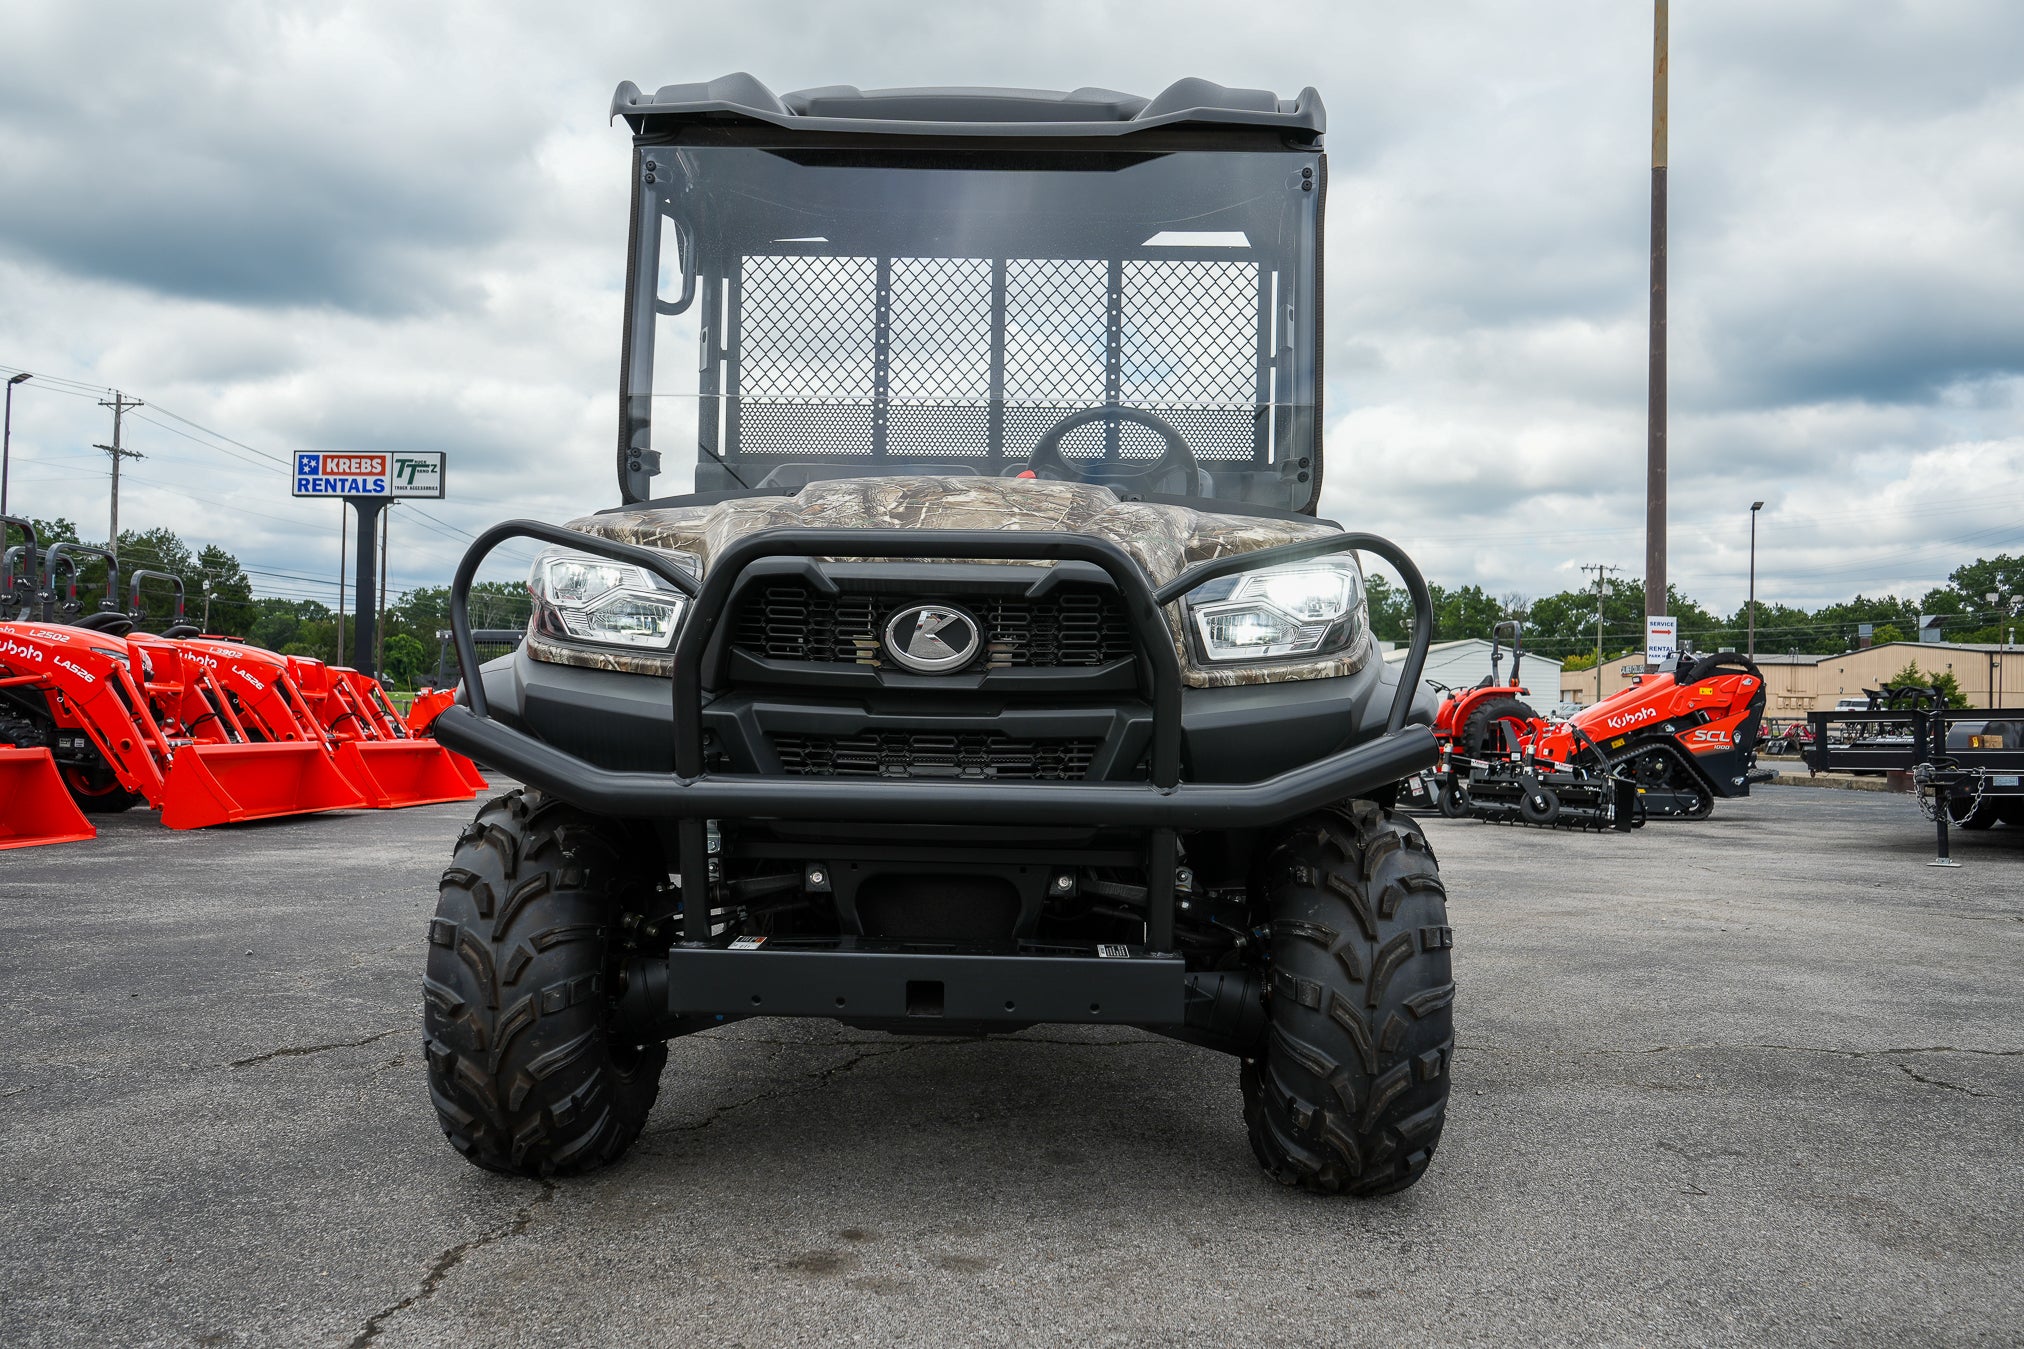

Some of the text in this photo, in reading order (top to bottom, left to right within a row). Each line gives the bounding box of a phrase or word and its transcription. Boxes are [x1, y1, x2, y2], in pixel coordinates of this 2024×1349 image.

[326, 458, 382, 473] KREBS
[297, 478, 385, 493] RENTALS
[29, 629, 71, 643] L2502
[53, 655, 96, 683] LA526
[231, 664, 265, 691] LA526
[1607, 707, 1656, 728] Kubota
[1692, 730, 1730, 742] SCL
